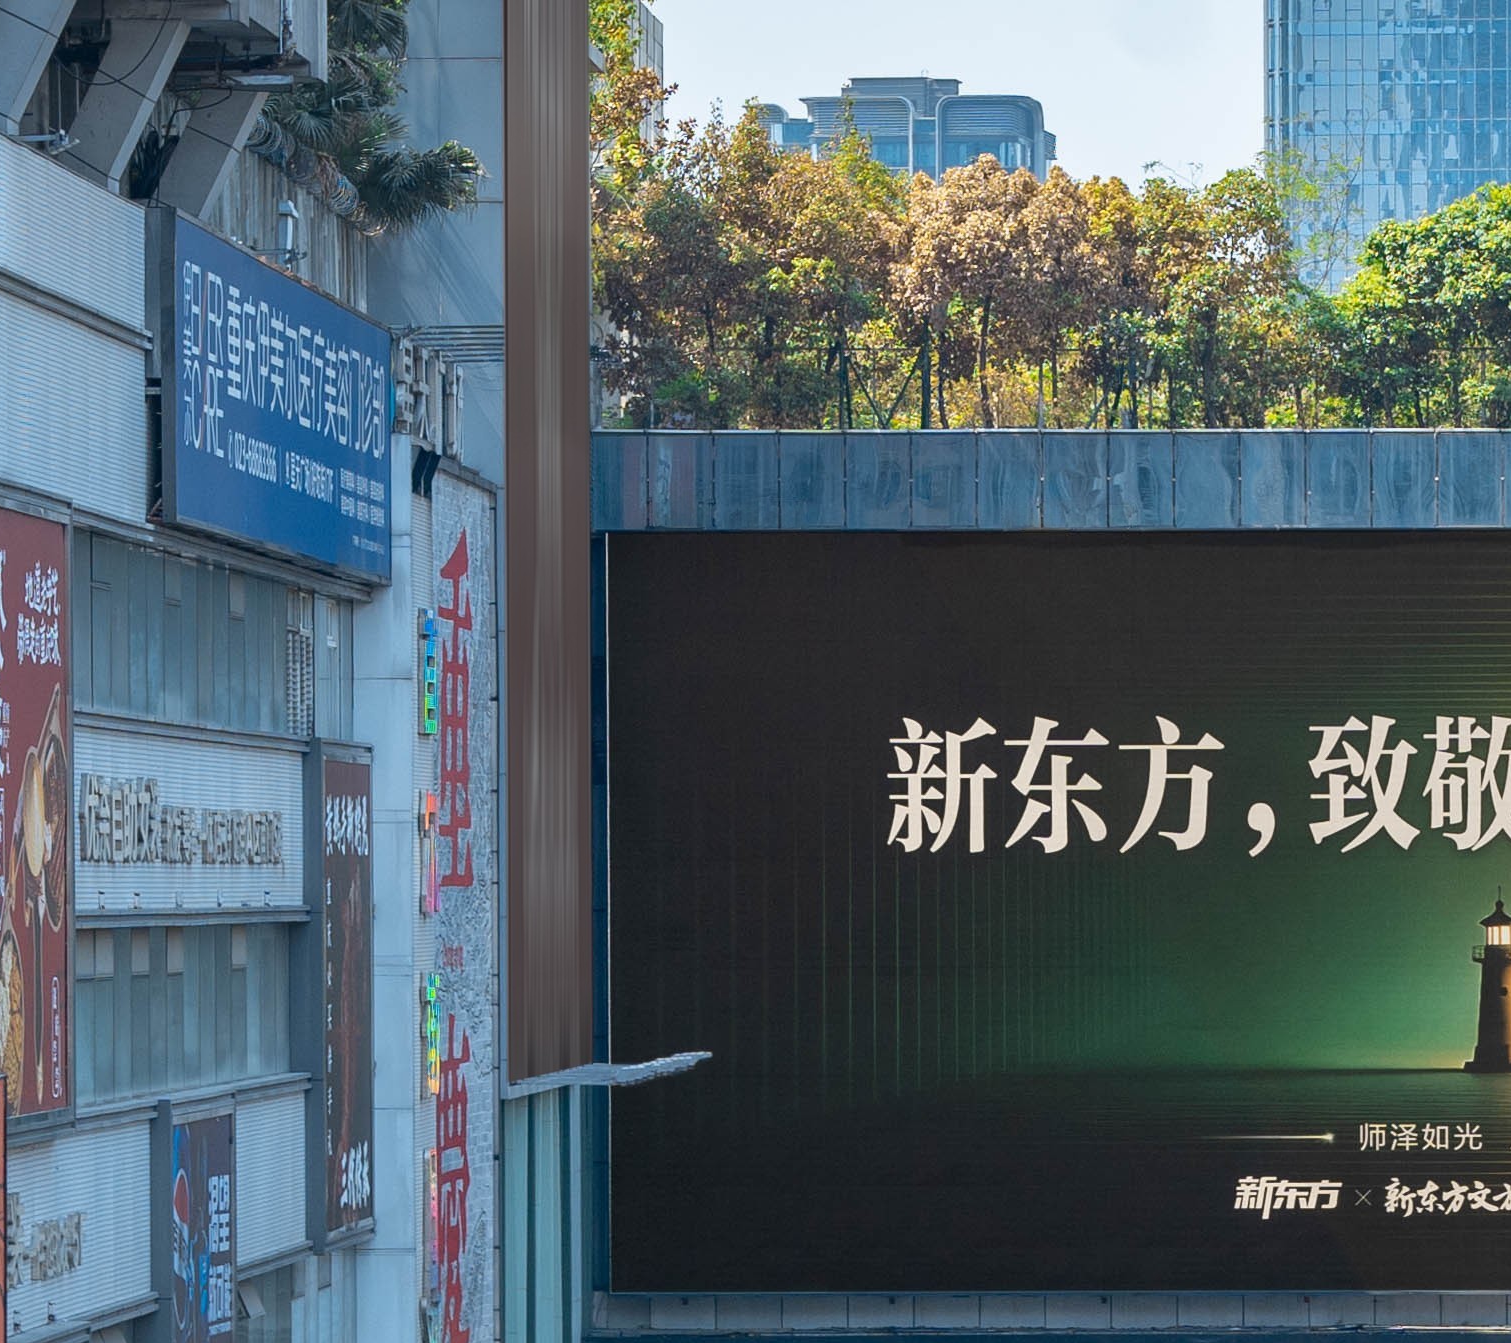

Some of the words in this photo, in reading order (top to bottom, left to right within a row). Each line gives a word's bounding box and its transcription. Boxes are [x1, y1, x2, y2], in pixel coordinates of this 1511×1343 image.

[227, 284, 385, 461] 重庆伊美尔医疗美容门诊部
[1358, 1122, 1483, 1152] 师泽如光
[1233, 1176, 1343, 1219] 新东方
